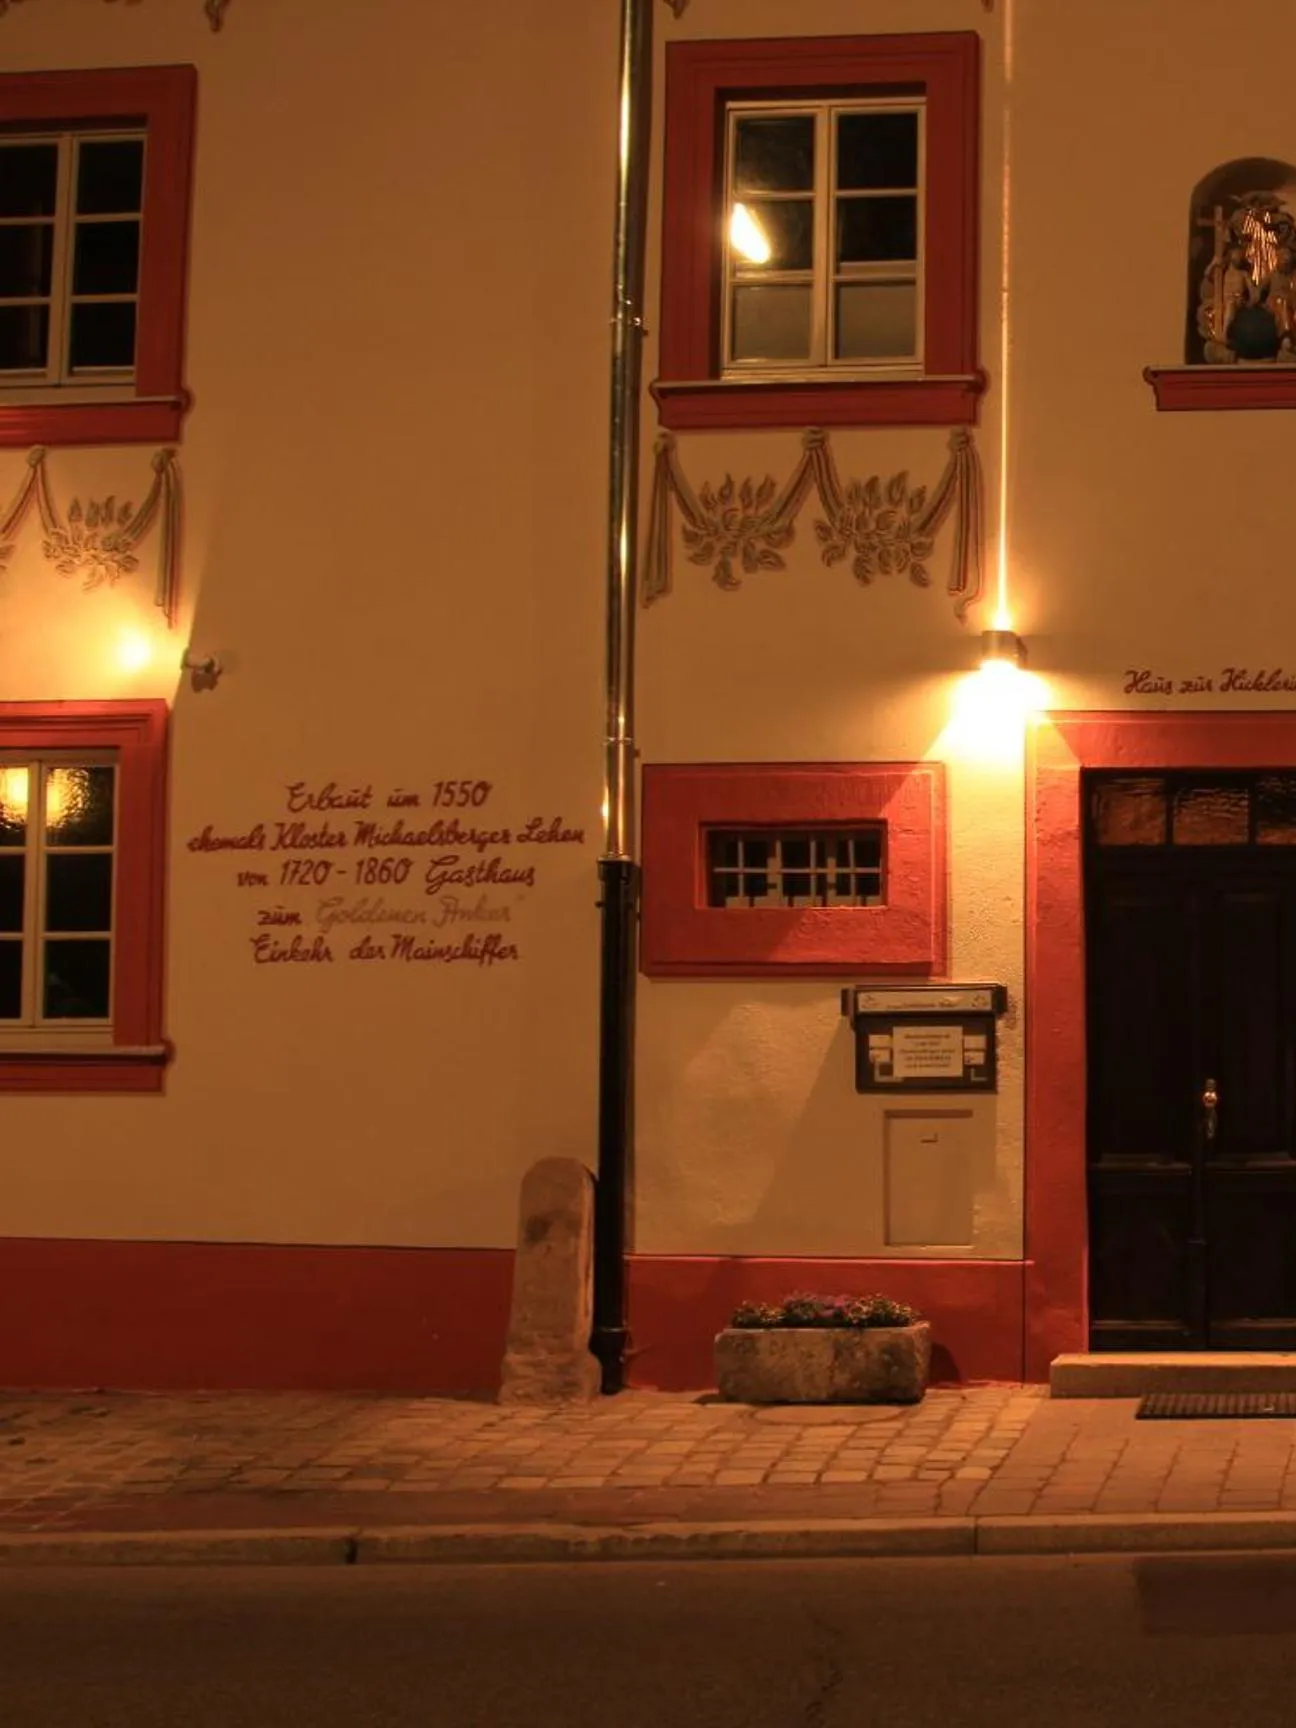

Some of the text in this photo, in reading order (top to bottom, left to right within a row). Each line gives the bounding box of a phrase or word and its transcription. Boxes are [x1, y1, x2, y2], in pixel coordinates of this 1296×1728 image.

[432, 780, 493, 808] 1550
[270, 821, 349, 852] Kloster
[516, 817, 585, 844] Lehen
[237, 868, 269, 888] von
[280, 858, 334, 886] 1720
[355, 857, 414, 885] 1860
[425, 855, 535, 894] Gasthaus
[250, 933, 333, 964] Einkehr
[349, 935, 386, 961] der
